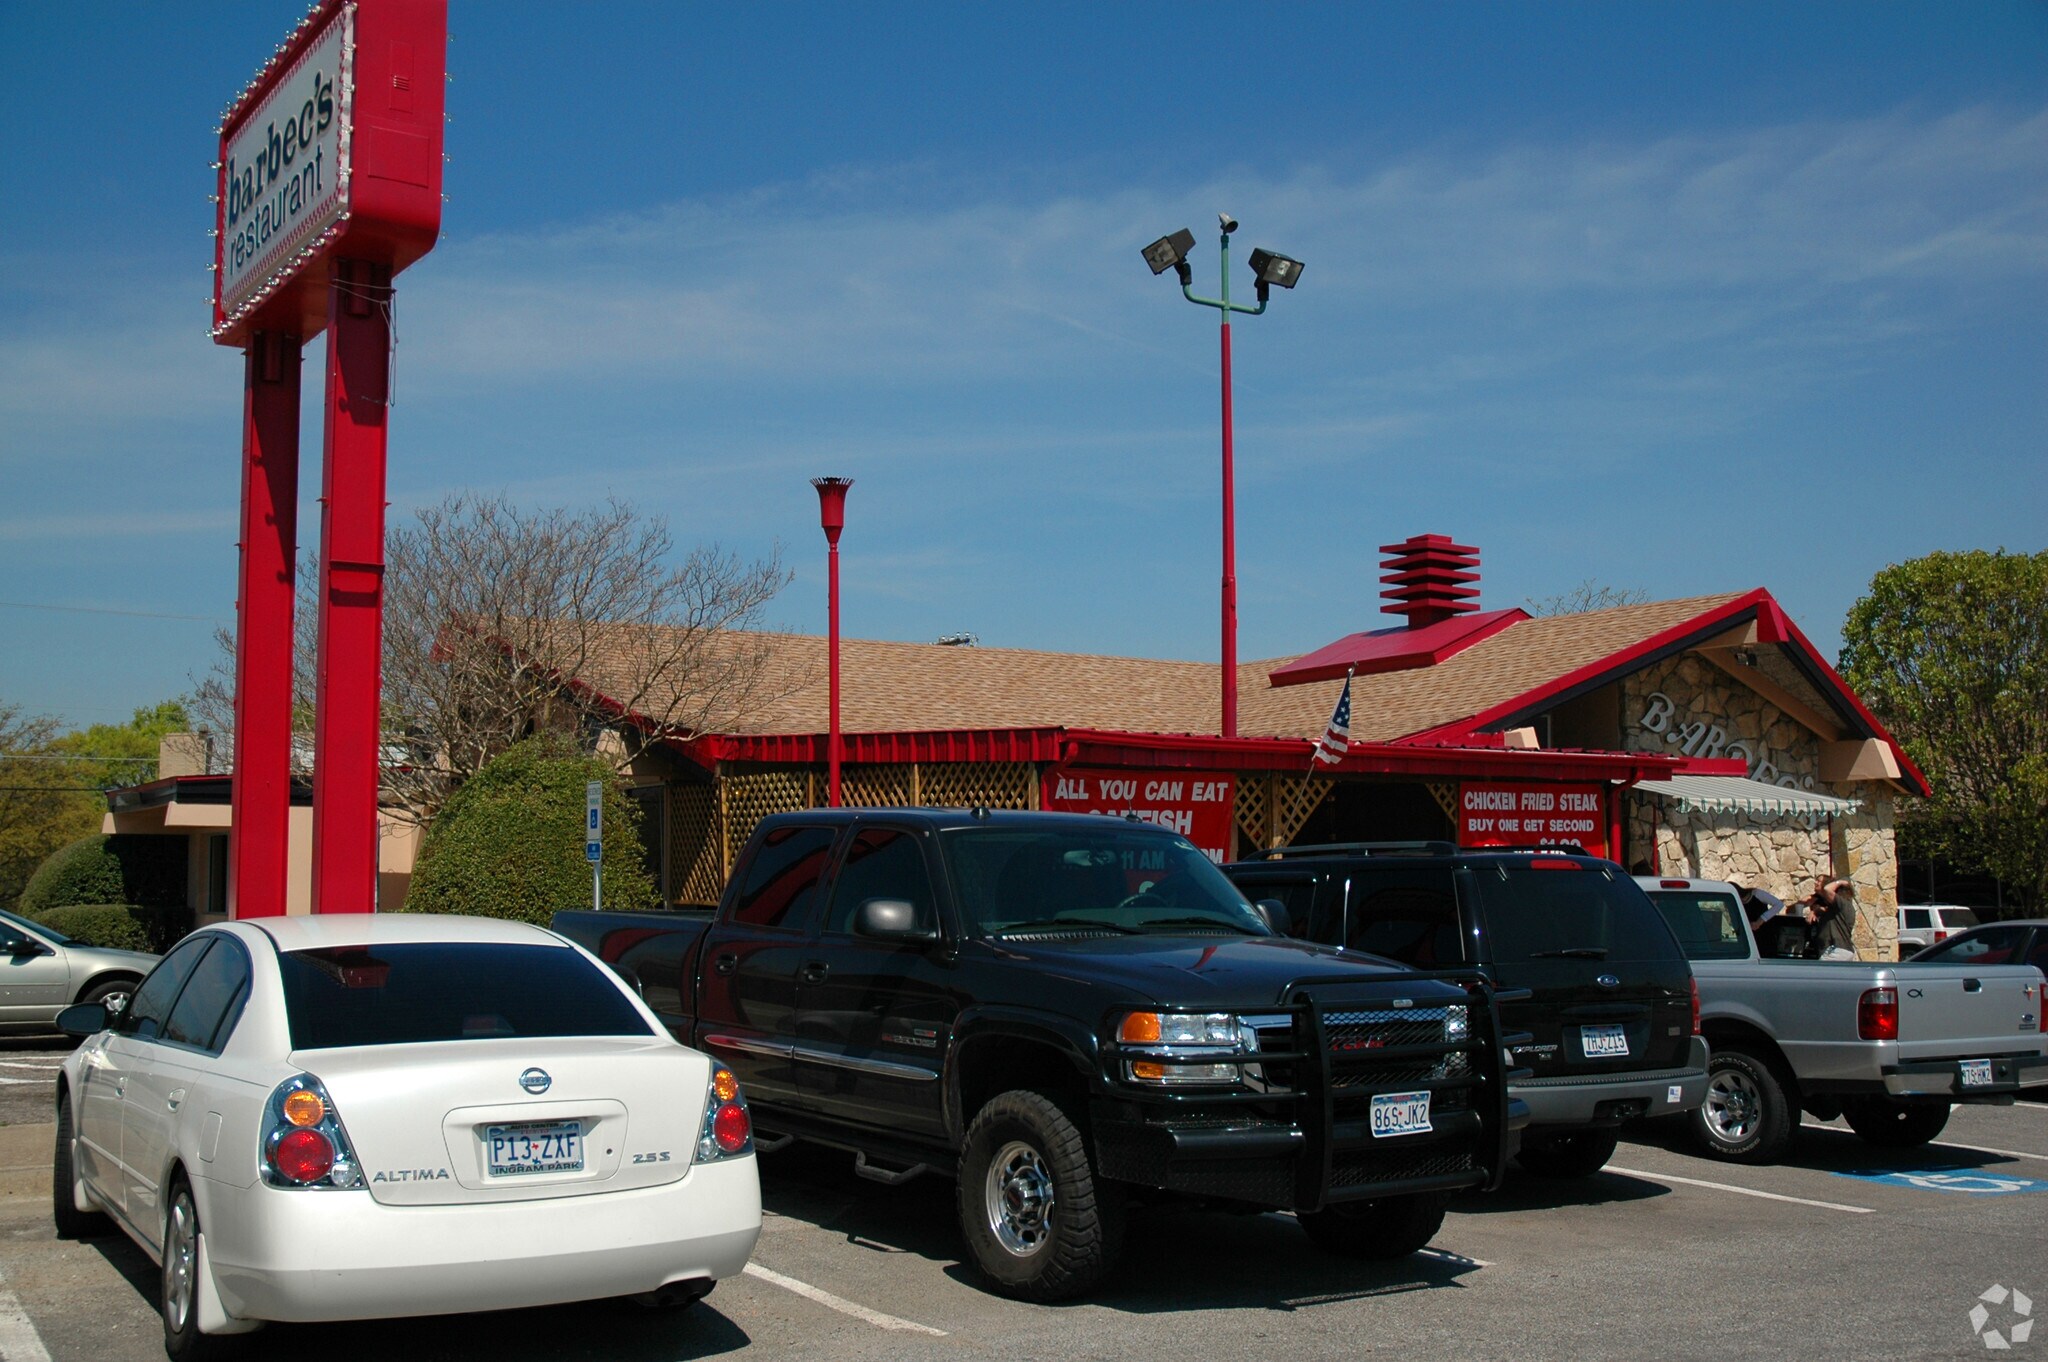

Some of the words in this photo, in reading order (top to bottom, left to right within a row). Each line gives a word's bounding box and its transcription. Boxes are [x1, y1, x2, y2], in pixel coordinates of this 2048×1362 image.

[227, 69, 335, 227] barbec's
[229, 147, 323, 276] restaurant
[1055, 779, 1089, 800] ALL
[1099, 780, 1137, 800] YOU
[1145, 781, 1183, 801] CAN
[1191, 782, 1228, 802] EAT
[1464, 791, 1516, 811] CHICKEN
[1521, 792, 1554, 811] FRIED
[1560, 793, 1598, 812] STEAK
[1468, 818, 1494, 832] BUY
[1498, 819, 1519, 832] ONE
[1523, 819, 1544, 832] GET
[1549, 819, 1595, 832] SECOND
[373, 1167, 450, 1184] ALTIMA
[495, 1164, 544, 1174] INGRAM
[548, 1161, 580, 1171] PARK
